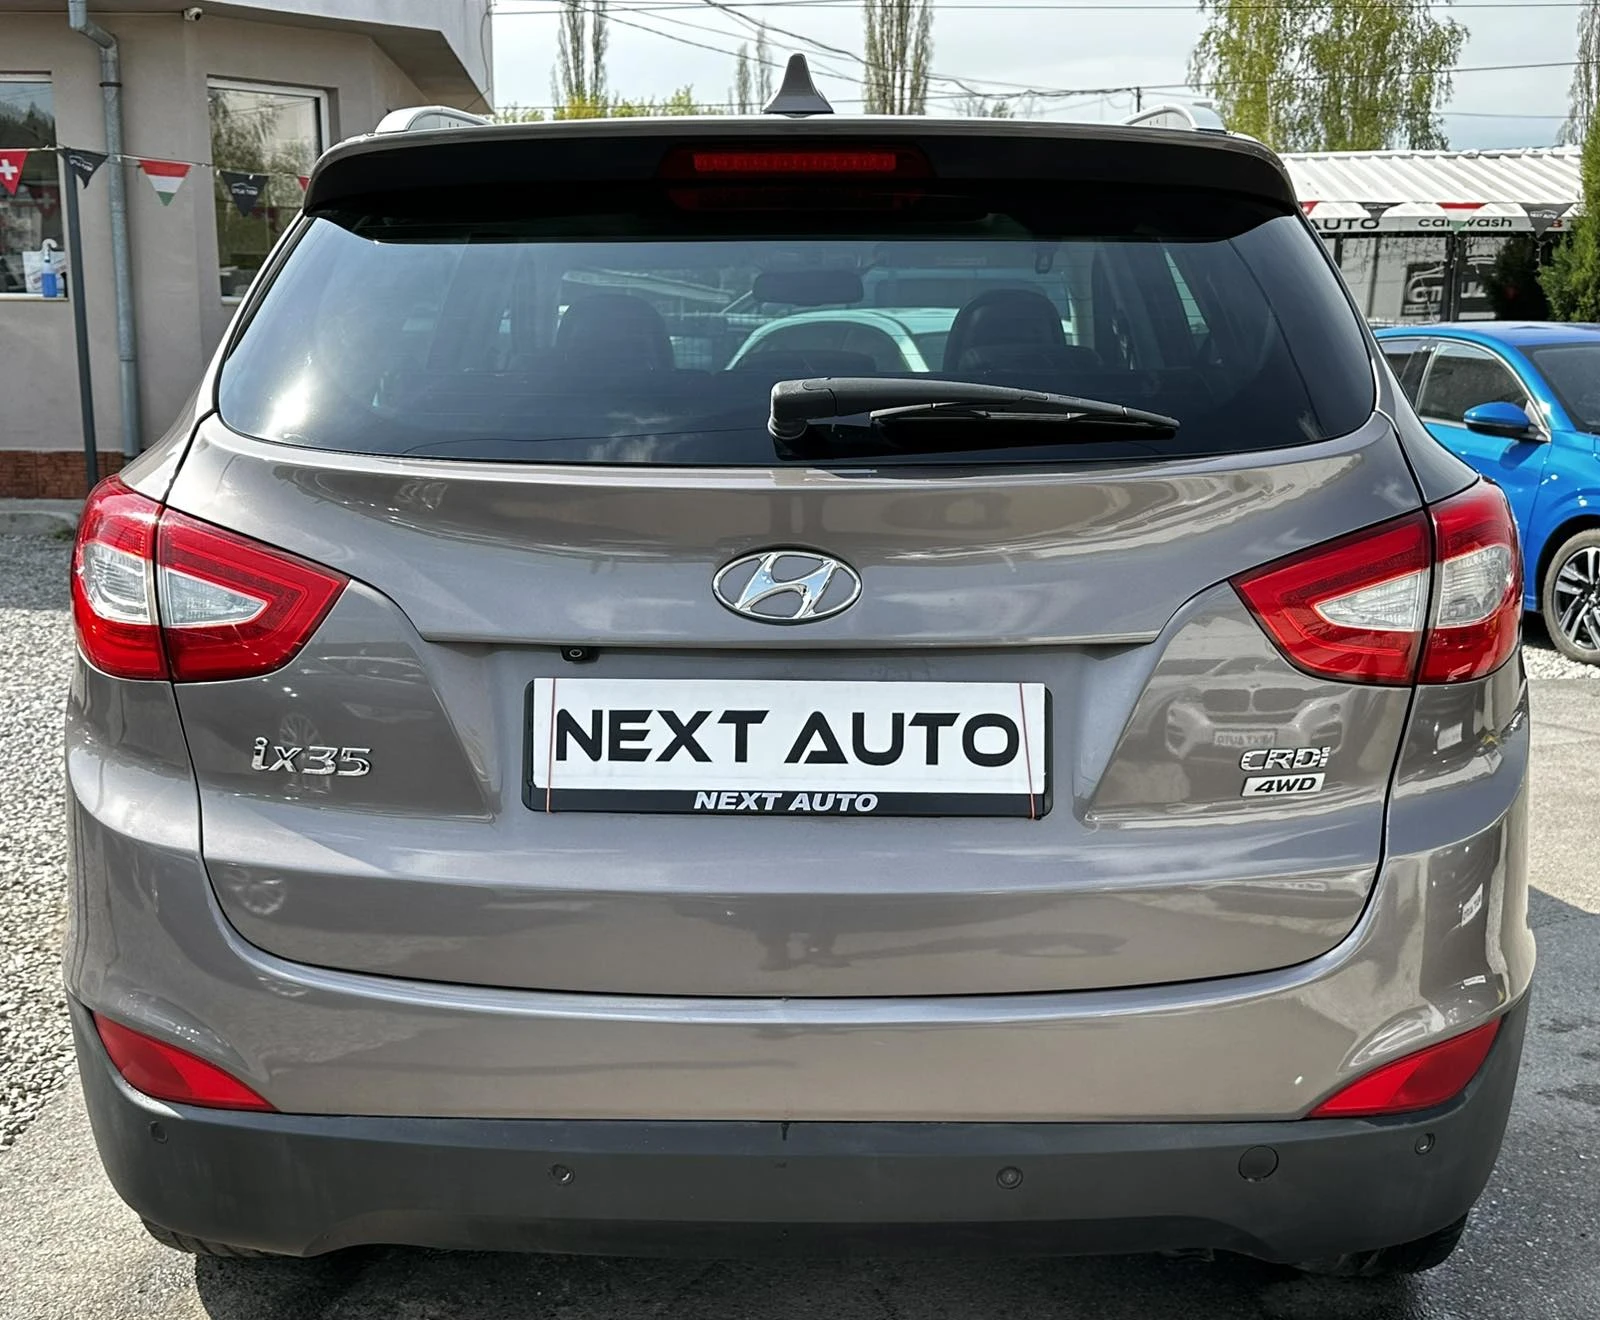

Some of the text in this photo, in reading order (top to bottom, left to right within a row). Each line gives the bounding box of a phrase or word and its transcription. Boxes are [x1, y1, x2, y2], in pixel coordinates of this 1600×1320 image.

[555, 708, 1020, 768] NEXT AUTO
[251, 736, 372, 777] ix35
[1240, 746, 1331, 771] CRDi
[1254, 777, 1317, 793] 4WD
[693, 791, 879, 813] NEXT AUTO
